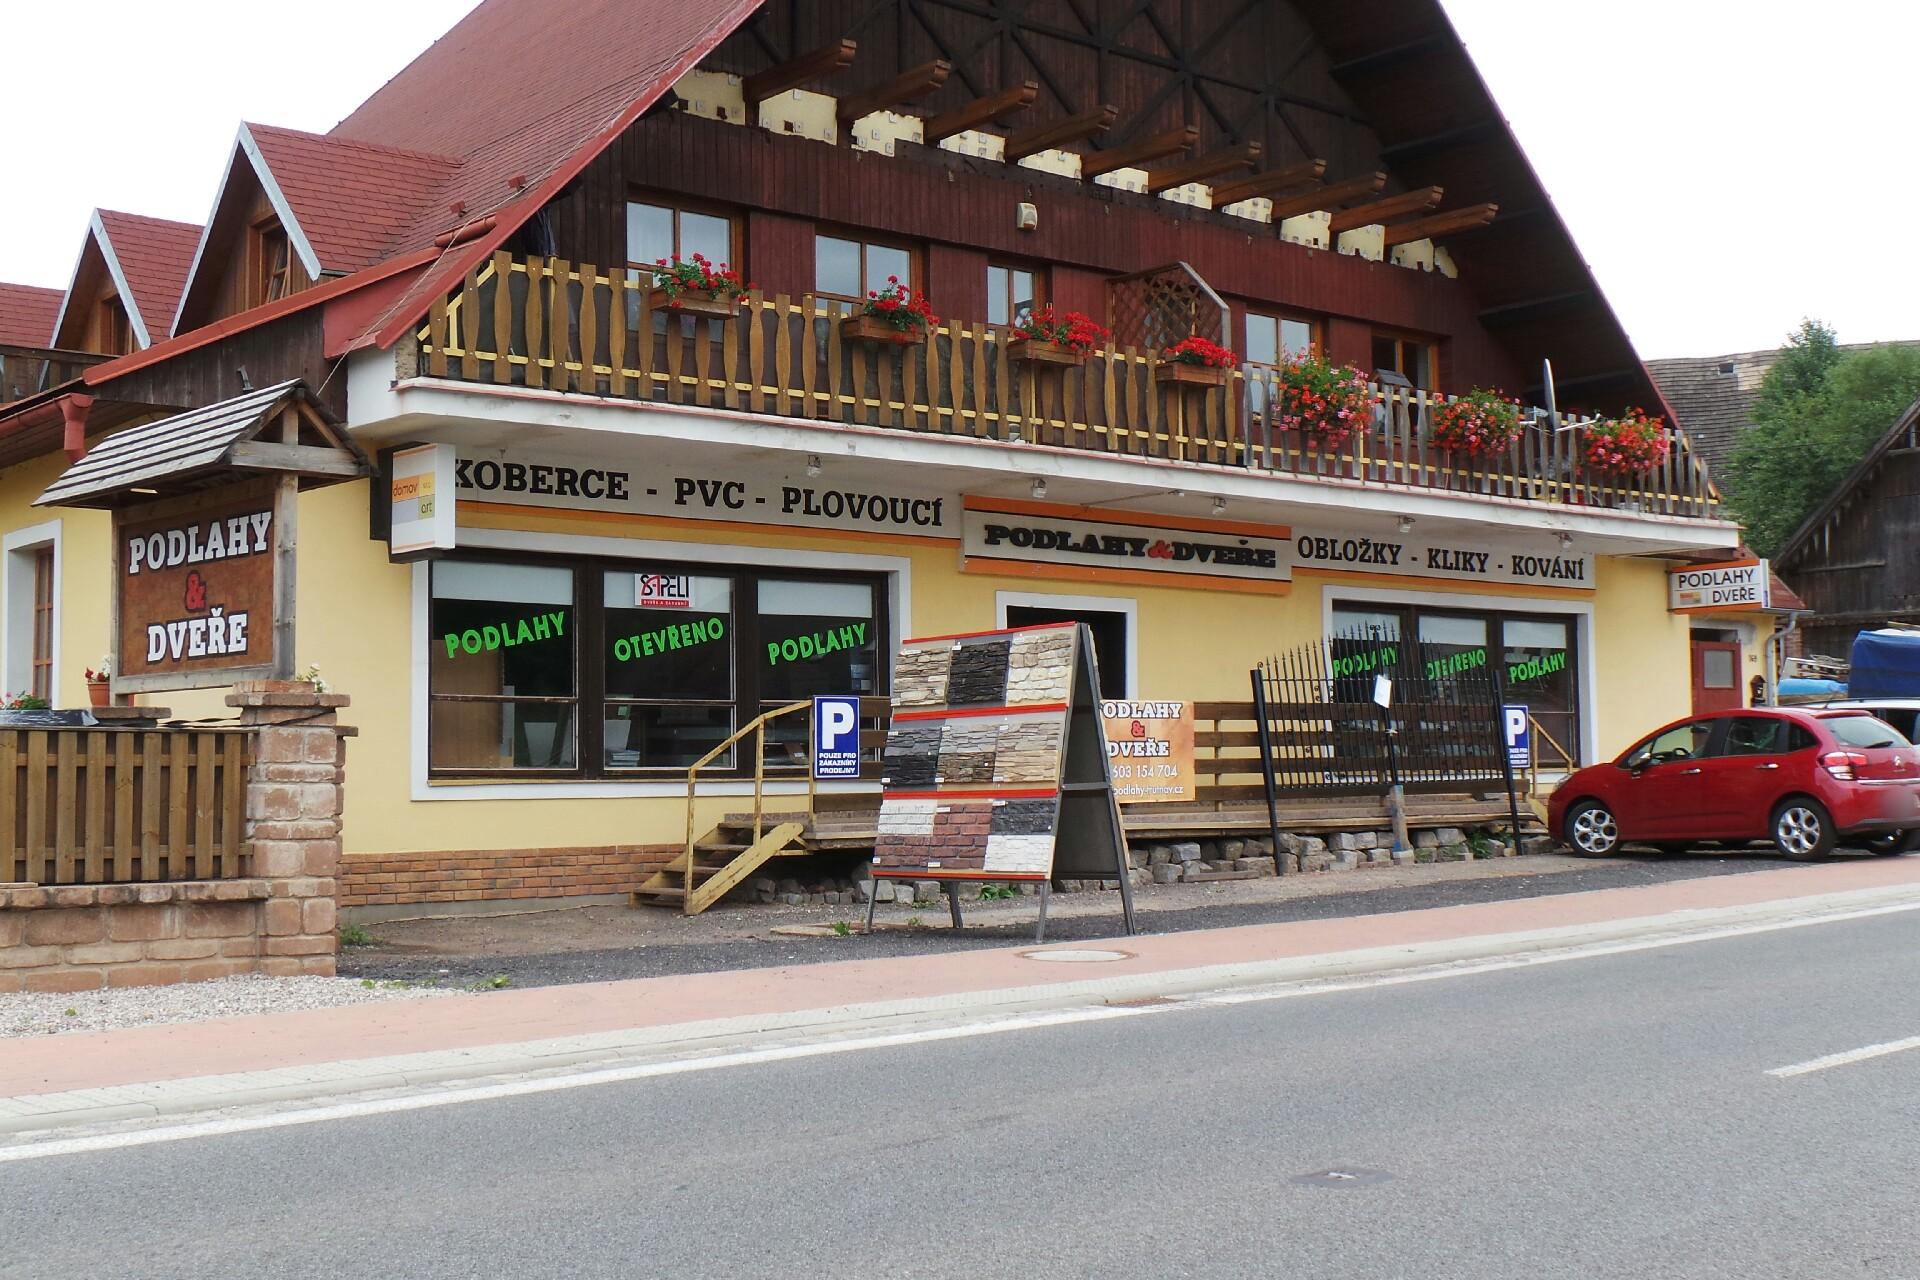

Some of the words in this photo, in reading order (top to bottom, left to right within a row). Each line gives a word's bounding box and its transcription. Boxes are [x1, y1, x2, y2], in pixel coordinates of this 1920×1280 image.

[393, 483, 418, 497] domov
[455, 459, 629, 501] KOBERCE
[674, 477, 745, 509] PVC
[782, 486, 944, 527] PLOVOUCÍ
[129, 511, 272, 575] PODLAHY
[1298, 536, 1402, 566] OBLOŽKY
[1427, 548, 1490, 573] KLIKY
[1511, 555, 1585, 580] KOVÁNÍ
[186, 573, 206, 610] &
[640, 574, 689, 598] SAPELI
[1678, 568, 1754, 589] PODLAHY
[1712, 586, 1756, 603] DVEŘE
[147, 607, 248, 662] DVEŘE
[445, 611, 565, 659] PODLAHY
[615, 617, 724, 662] OTEVŘENO
[767, 622, 866, 666] PODLAHY
[1510, 652, 1565, 684] PODLAHY
[821, 702, 855, 750] P
[1131, 720, 1145, 737] &
[1505, 709, 1526, 746] P
[1109, 738, 1170, 757] DVEŘE
[1136, 764, 1154, 777] 154
[1157, 764, 1178, 777] 704
